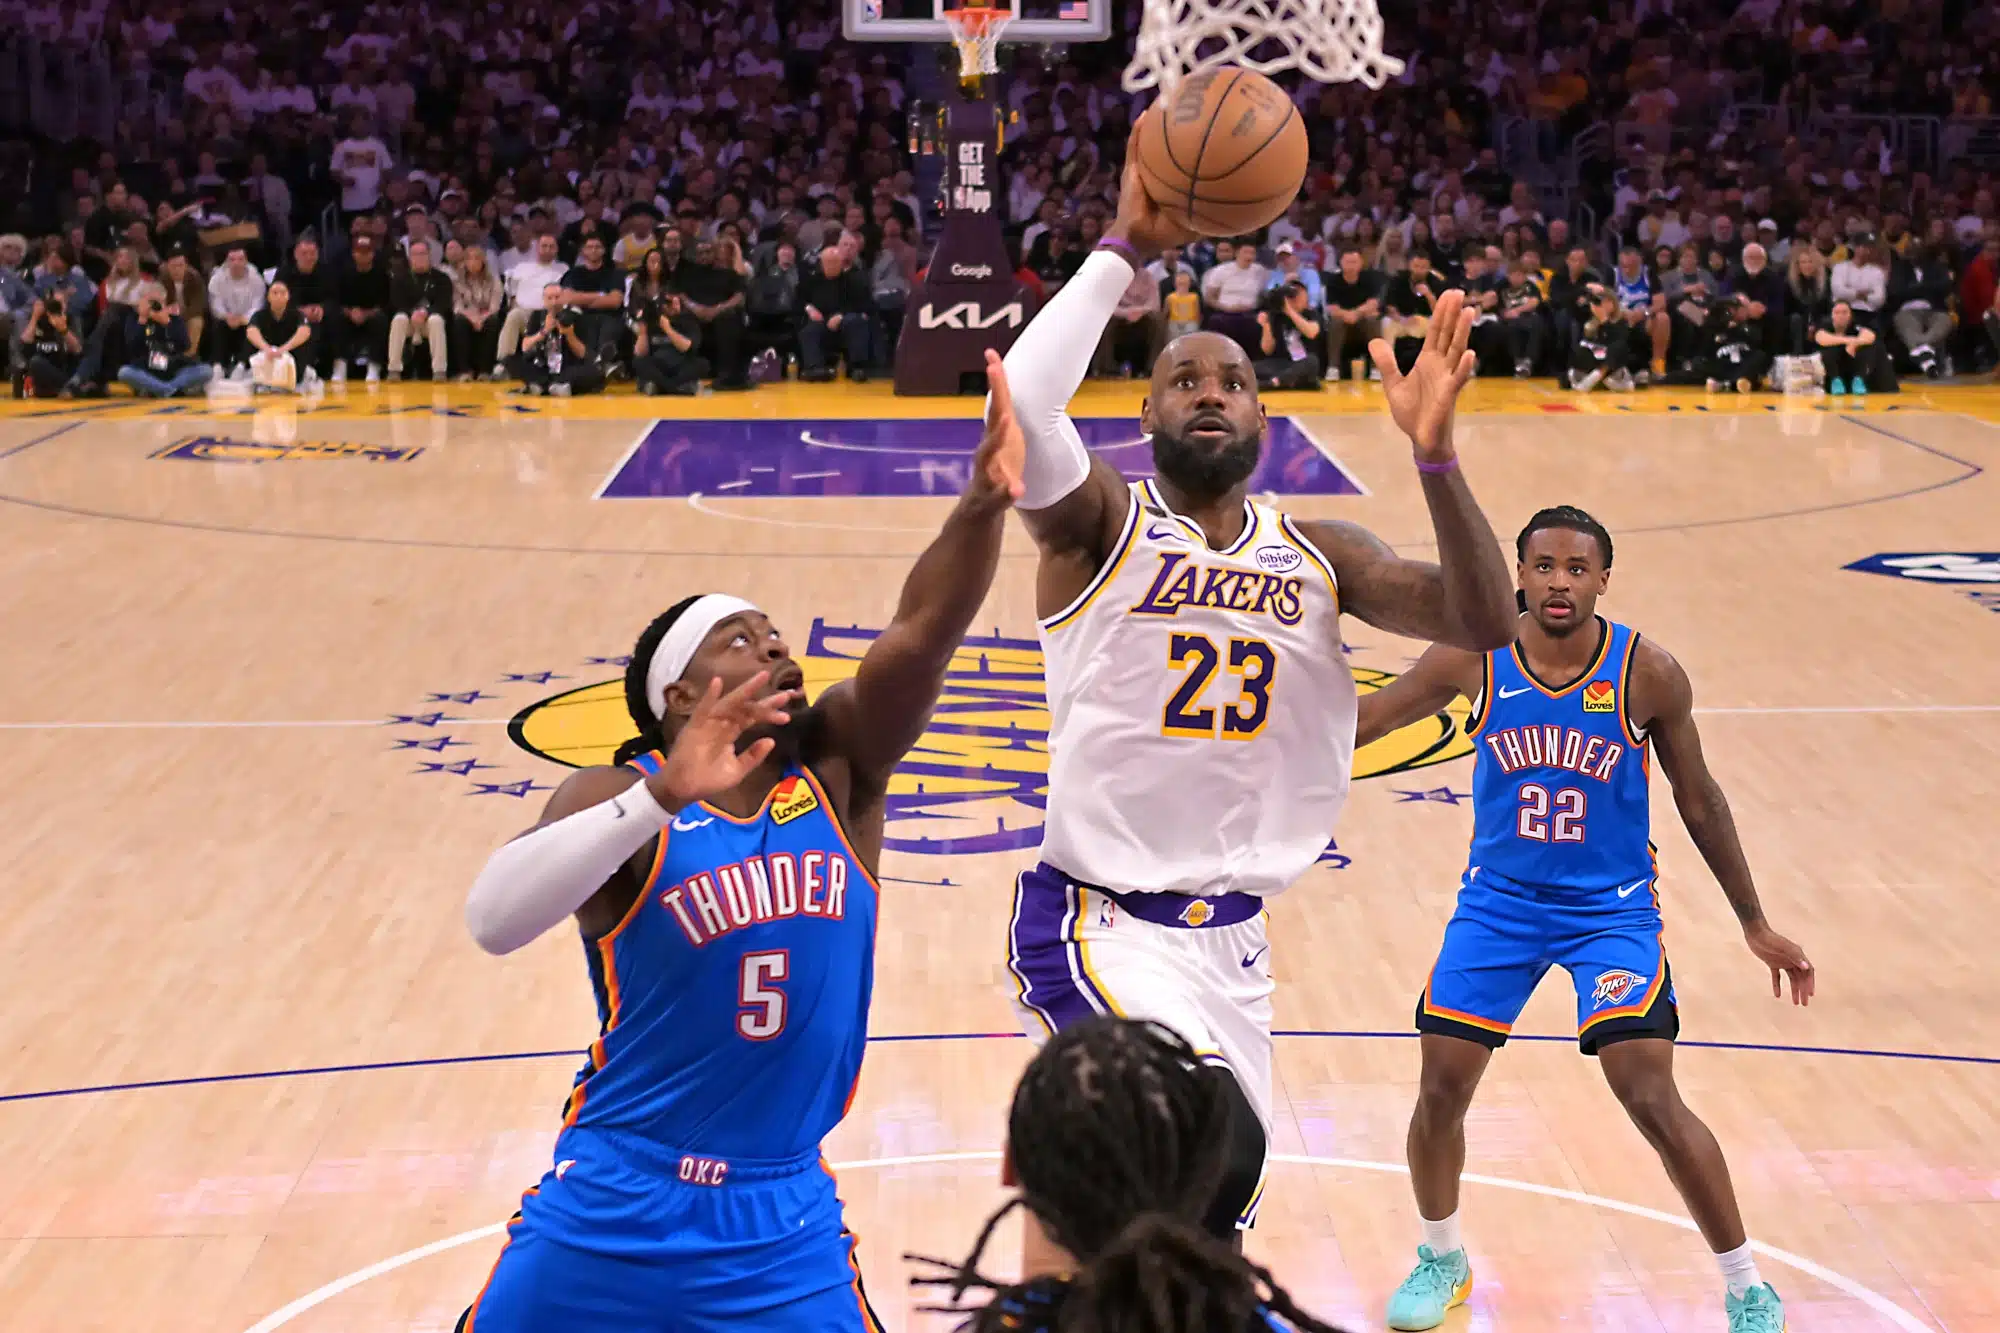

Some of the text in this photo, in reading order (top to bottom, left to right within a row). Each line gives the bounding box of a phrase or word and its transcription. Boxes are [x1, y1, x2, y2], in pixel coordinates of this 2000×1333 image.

[959, 142, 984, 163] GET
[959, 164, 985, 186] THE
[951, 263, 992, 278] Google
[919, 302, 1022, 328] KIA
[1258, 552, 1299, 565] bibigo
[1129, 551, 1304, 628] LAKERS
[1160, 632, 1279, 742] 23
[1486, 724, 1625, 784] THUNDER
[1517, 782, 1587, 843] 22
[660, 850, 849, 948] THUNDER
[736, 948, 790, 1042] 5
[1598, 976, 1627, 999] OKC
[679, 1155, 728, 1186] OKC
